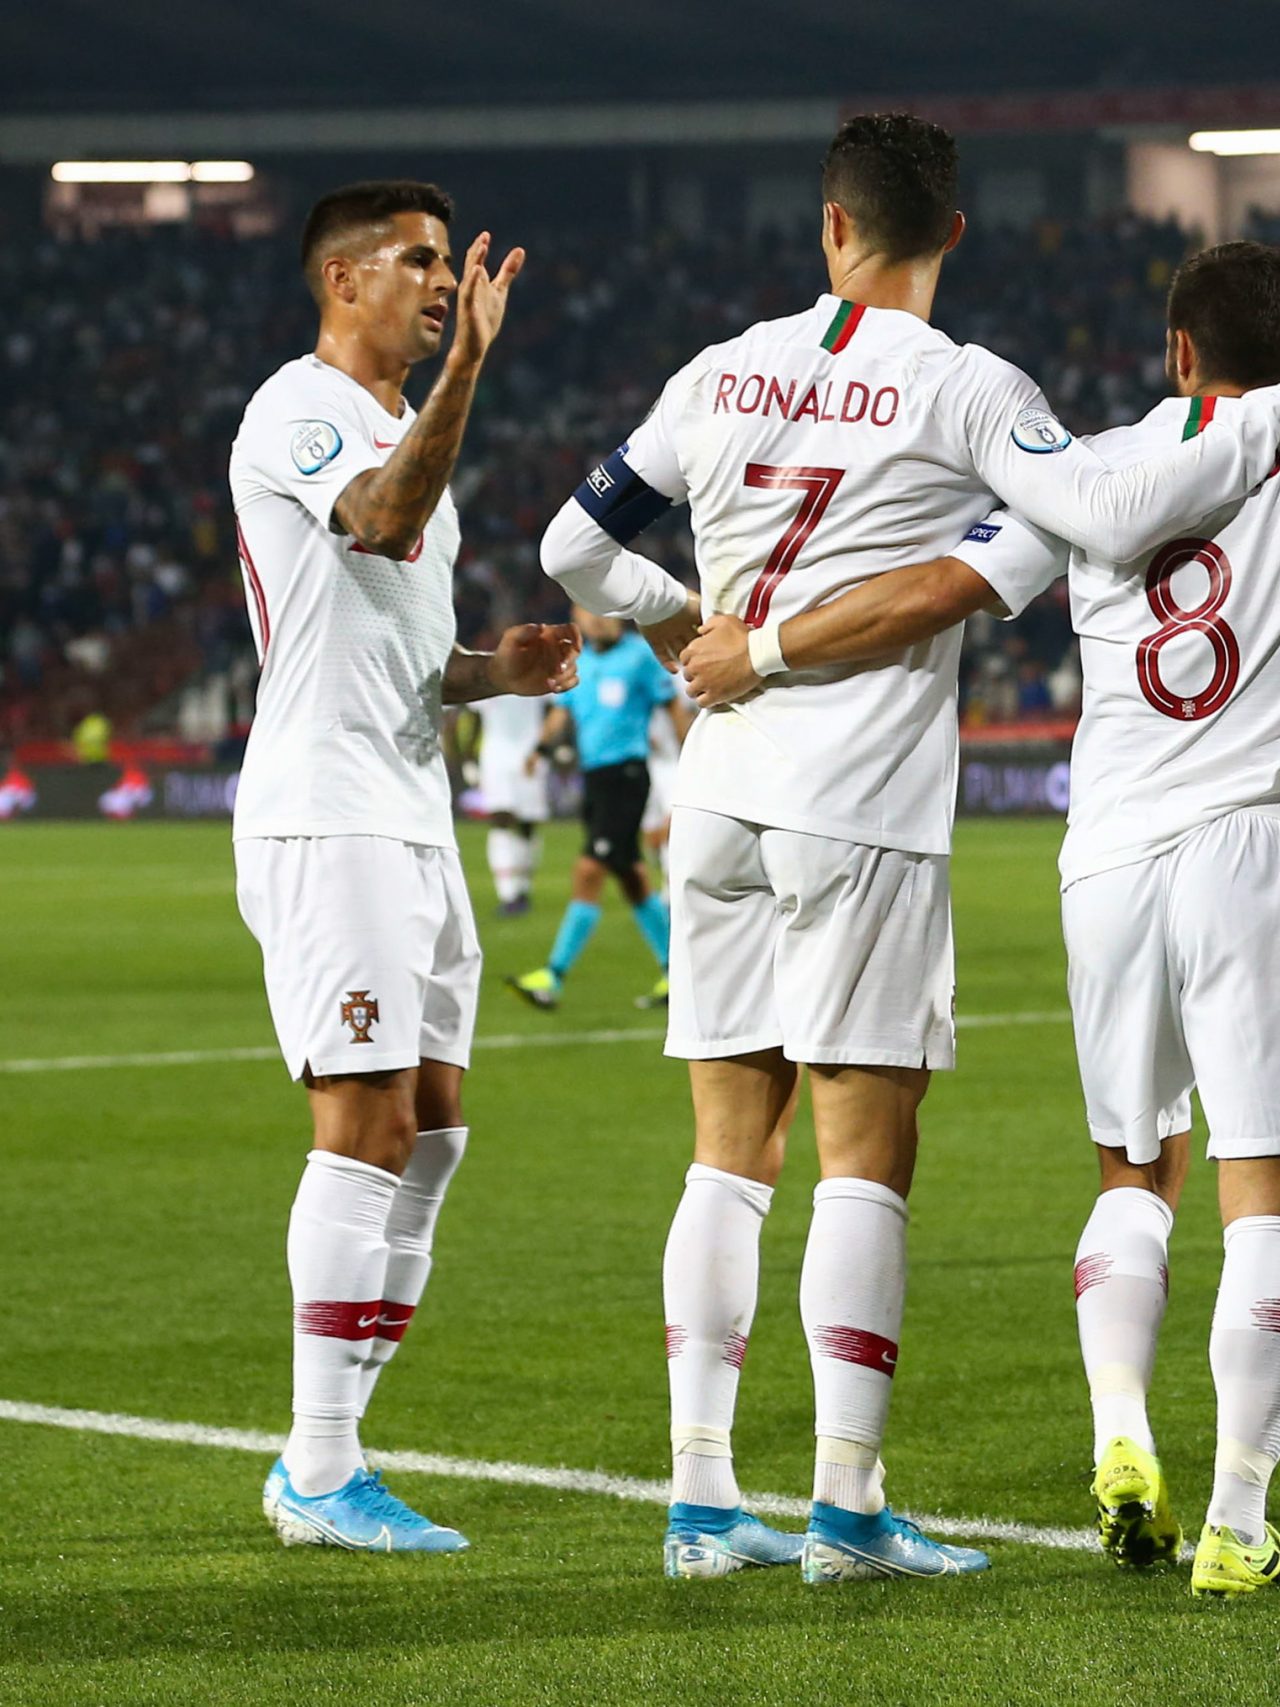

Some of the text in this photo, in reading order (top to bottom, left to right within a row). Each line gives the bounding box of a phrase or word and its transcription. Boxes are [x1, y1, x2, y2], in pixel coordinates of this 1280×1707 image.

[713, 373, 900, 427] RONALDO
[743, 462, 847, 630] 7
[968, 527, 998, 539] SPECT
[1135, 536, 1241, 722] 8
